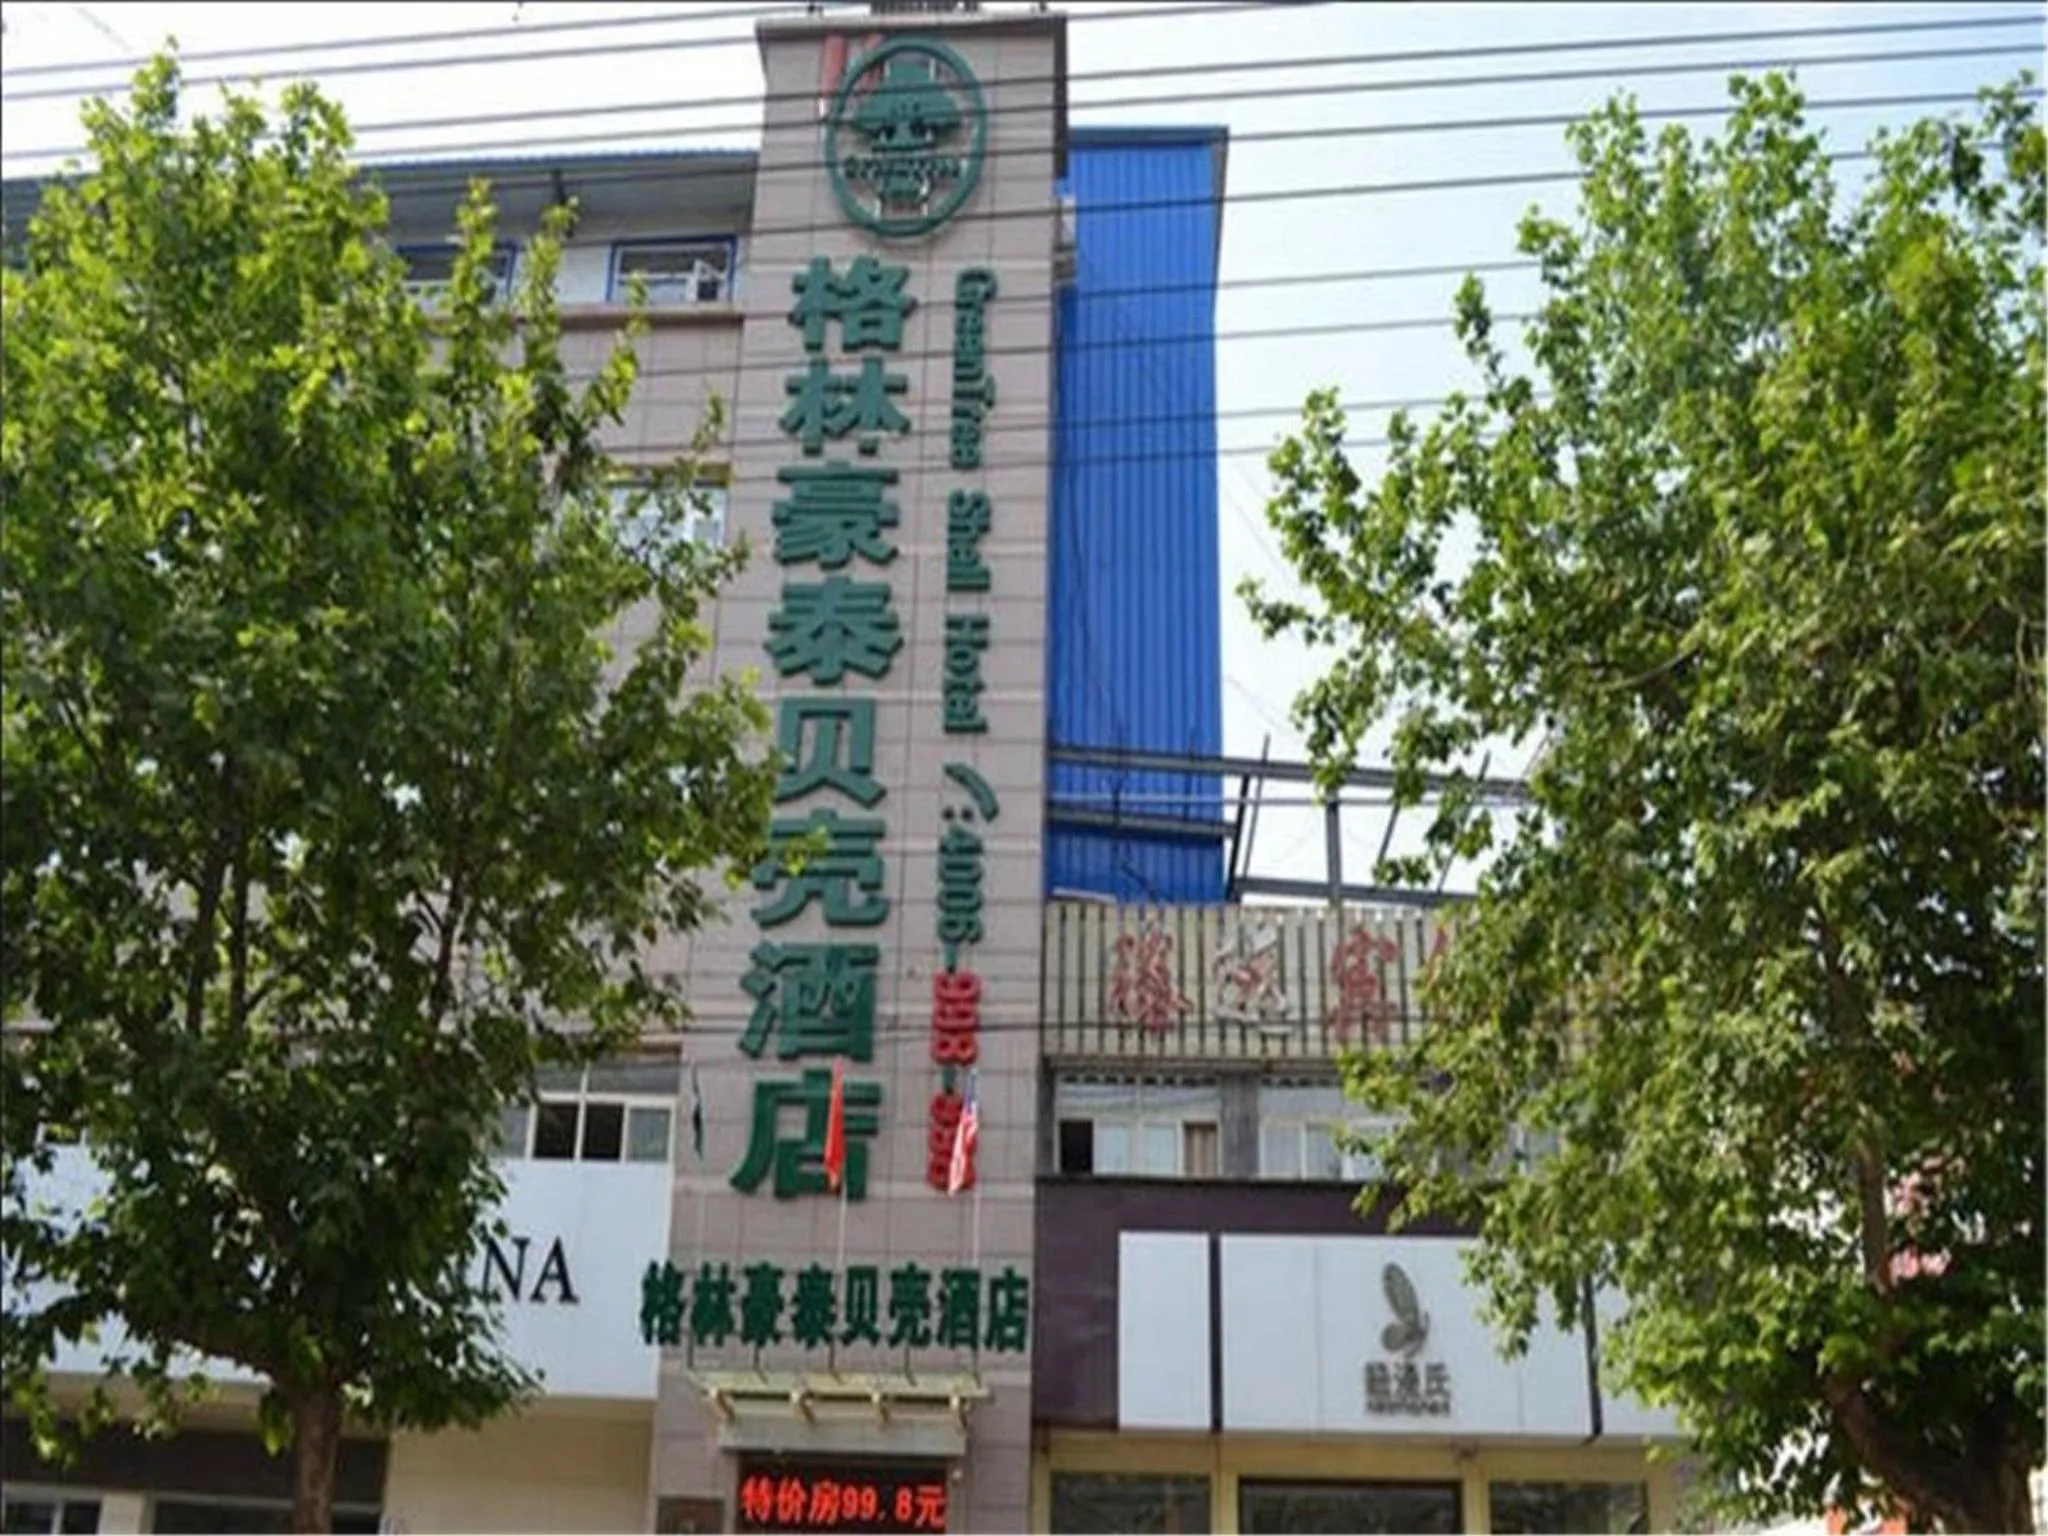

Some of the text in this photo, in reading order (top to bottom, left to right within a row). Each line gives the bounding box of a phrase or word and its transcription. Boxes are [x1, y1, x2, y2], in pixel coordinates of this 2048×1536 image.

[953, 268, 997, 471] GreenTree
[946, 489, 991, 592] Shell
[731, 256, 917, 1200] 格林豪泰贝壳酒店
[942, 615, 990, 733] Hotel
[640, 1260, 1030, 1352] 格林豪泰贝壳酒店
